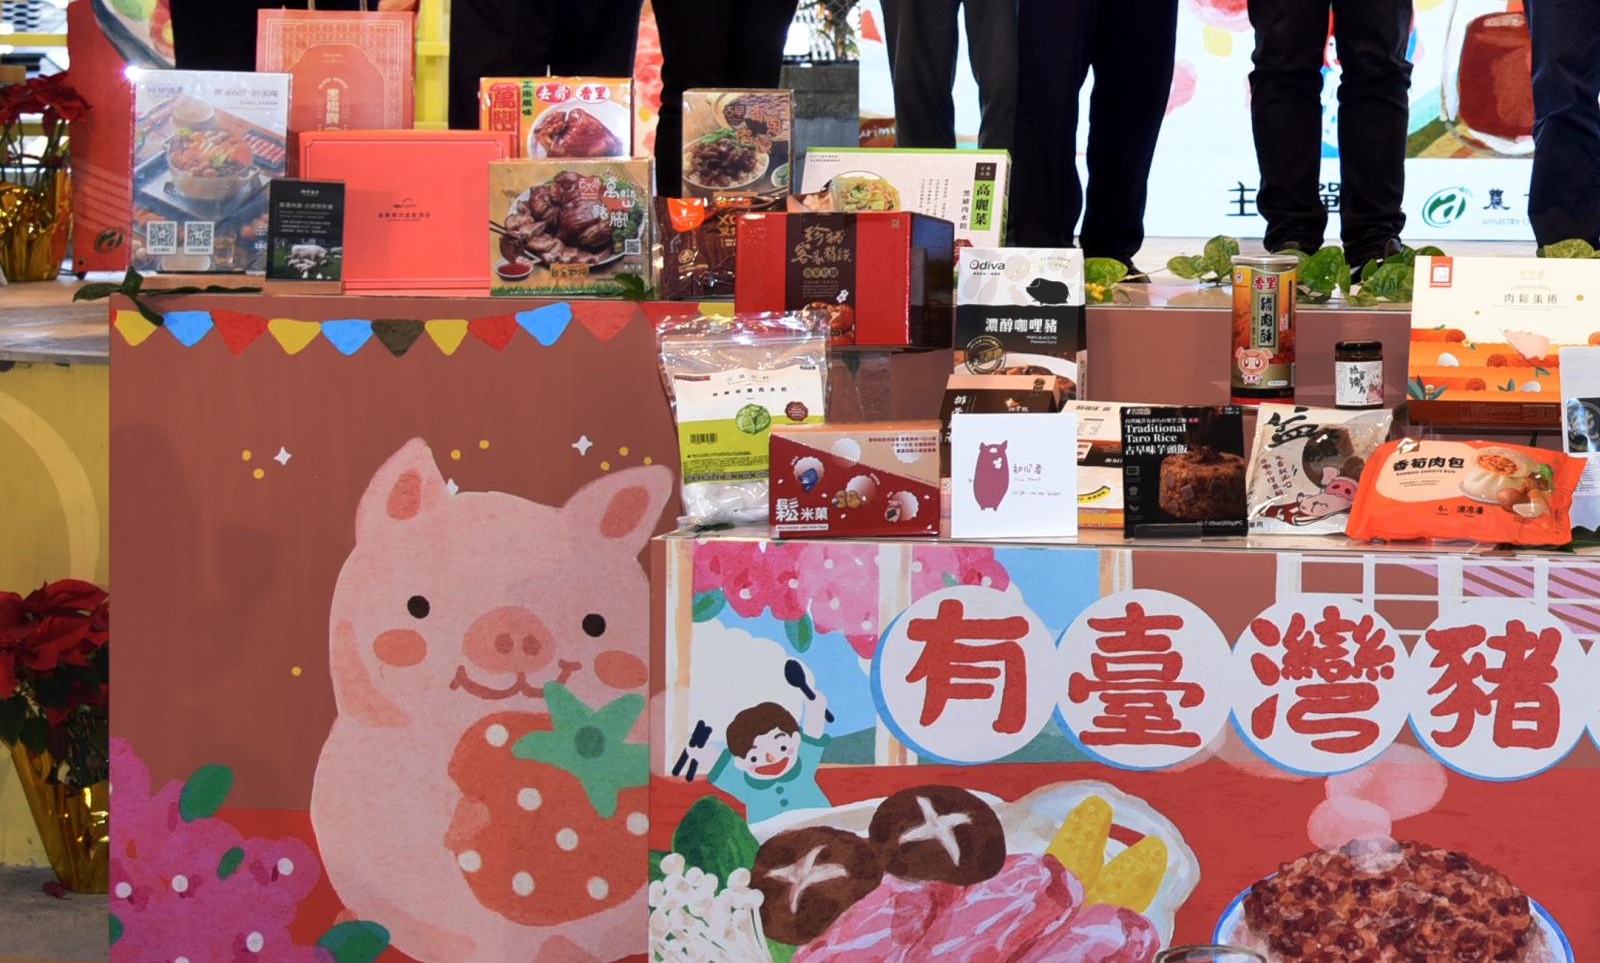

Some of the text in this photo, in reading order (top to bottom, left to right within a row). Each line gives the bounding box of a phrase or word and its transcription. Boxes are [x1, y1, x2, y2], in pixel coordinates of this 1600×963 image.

[537, 85, 608, 101] 去骨 香里
[974, 182, 991, 227] 高麗菜
[1254, 275, 1278, 292] 香里
[1504, 293, 1559, 305] 肉鬆蛋捲
[985, 318, 1058, 334] 濃醇咖哩豬
[1125, 423, 1187, 433] Traditional
[1125, 433, 1177, 443] Taro Rice
[1125, 444, 1189, 455] 古早味芋頭飯
[1392, 456, 1466, 472] 香筍肉包
[775, 497, 829, 523] 鬆米菓
